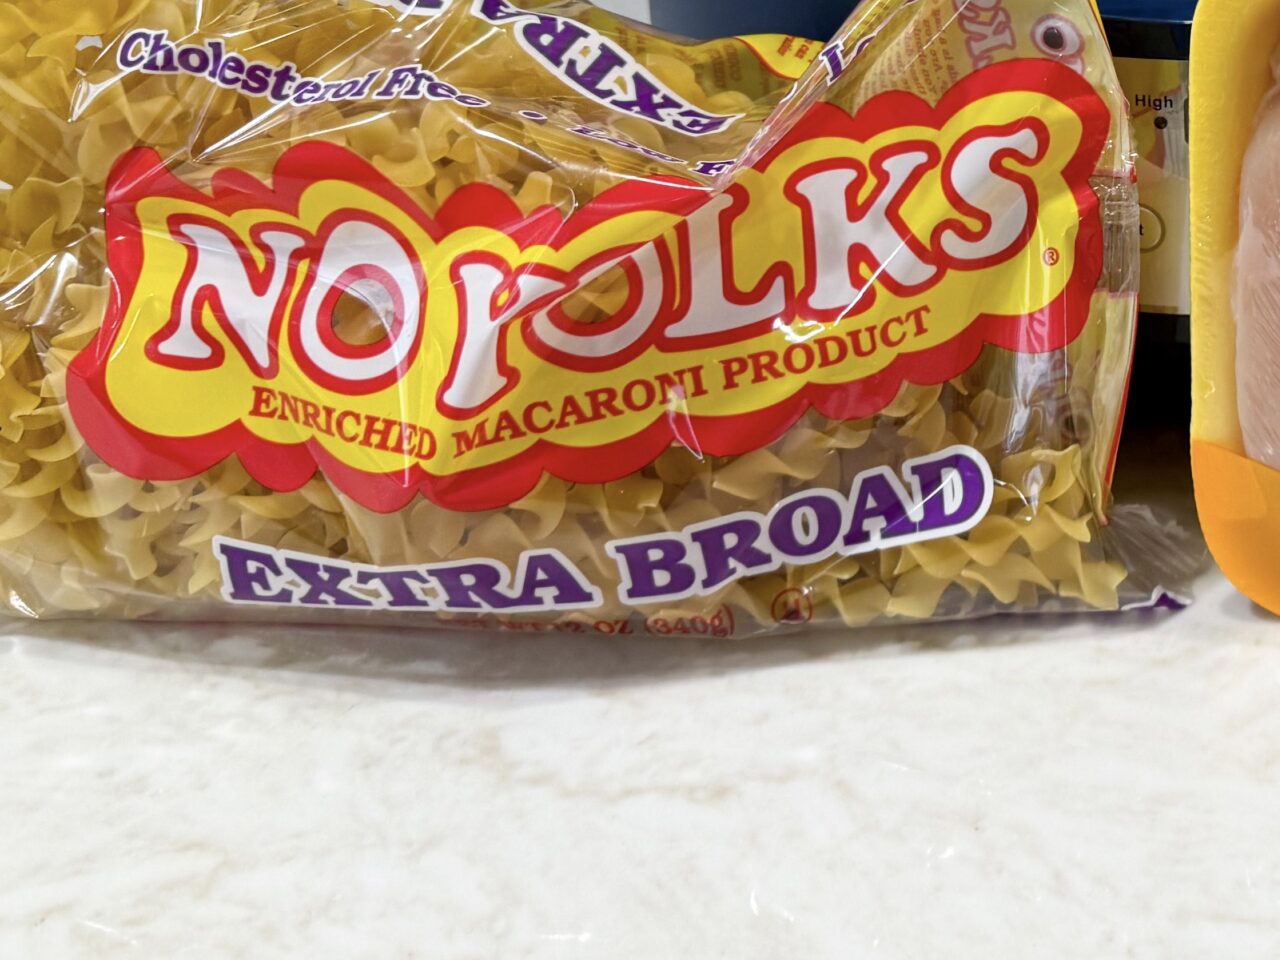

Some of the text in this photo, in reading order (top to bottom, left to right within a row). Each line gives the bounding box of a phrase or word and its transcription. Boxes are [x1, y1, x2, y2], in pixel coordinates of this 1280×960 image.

[118, 31, 376, 103] Cholesterol
[378, 66, 488, 107] Free
[1135, 94, 1173, 110] High
[148, 120, 1046, 415] NO YOLKS
[248, 304, 931, 461] ENRICHED MACARONI PRODUCT
[219, 453, 986, 609] EXTRA BROAD
[645, 604, 735, 638] (340g)
